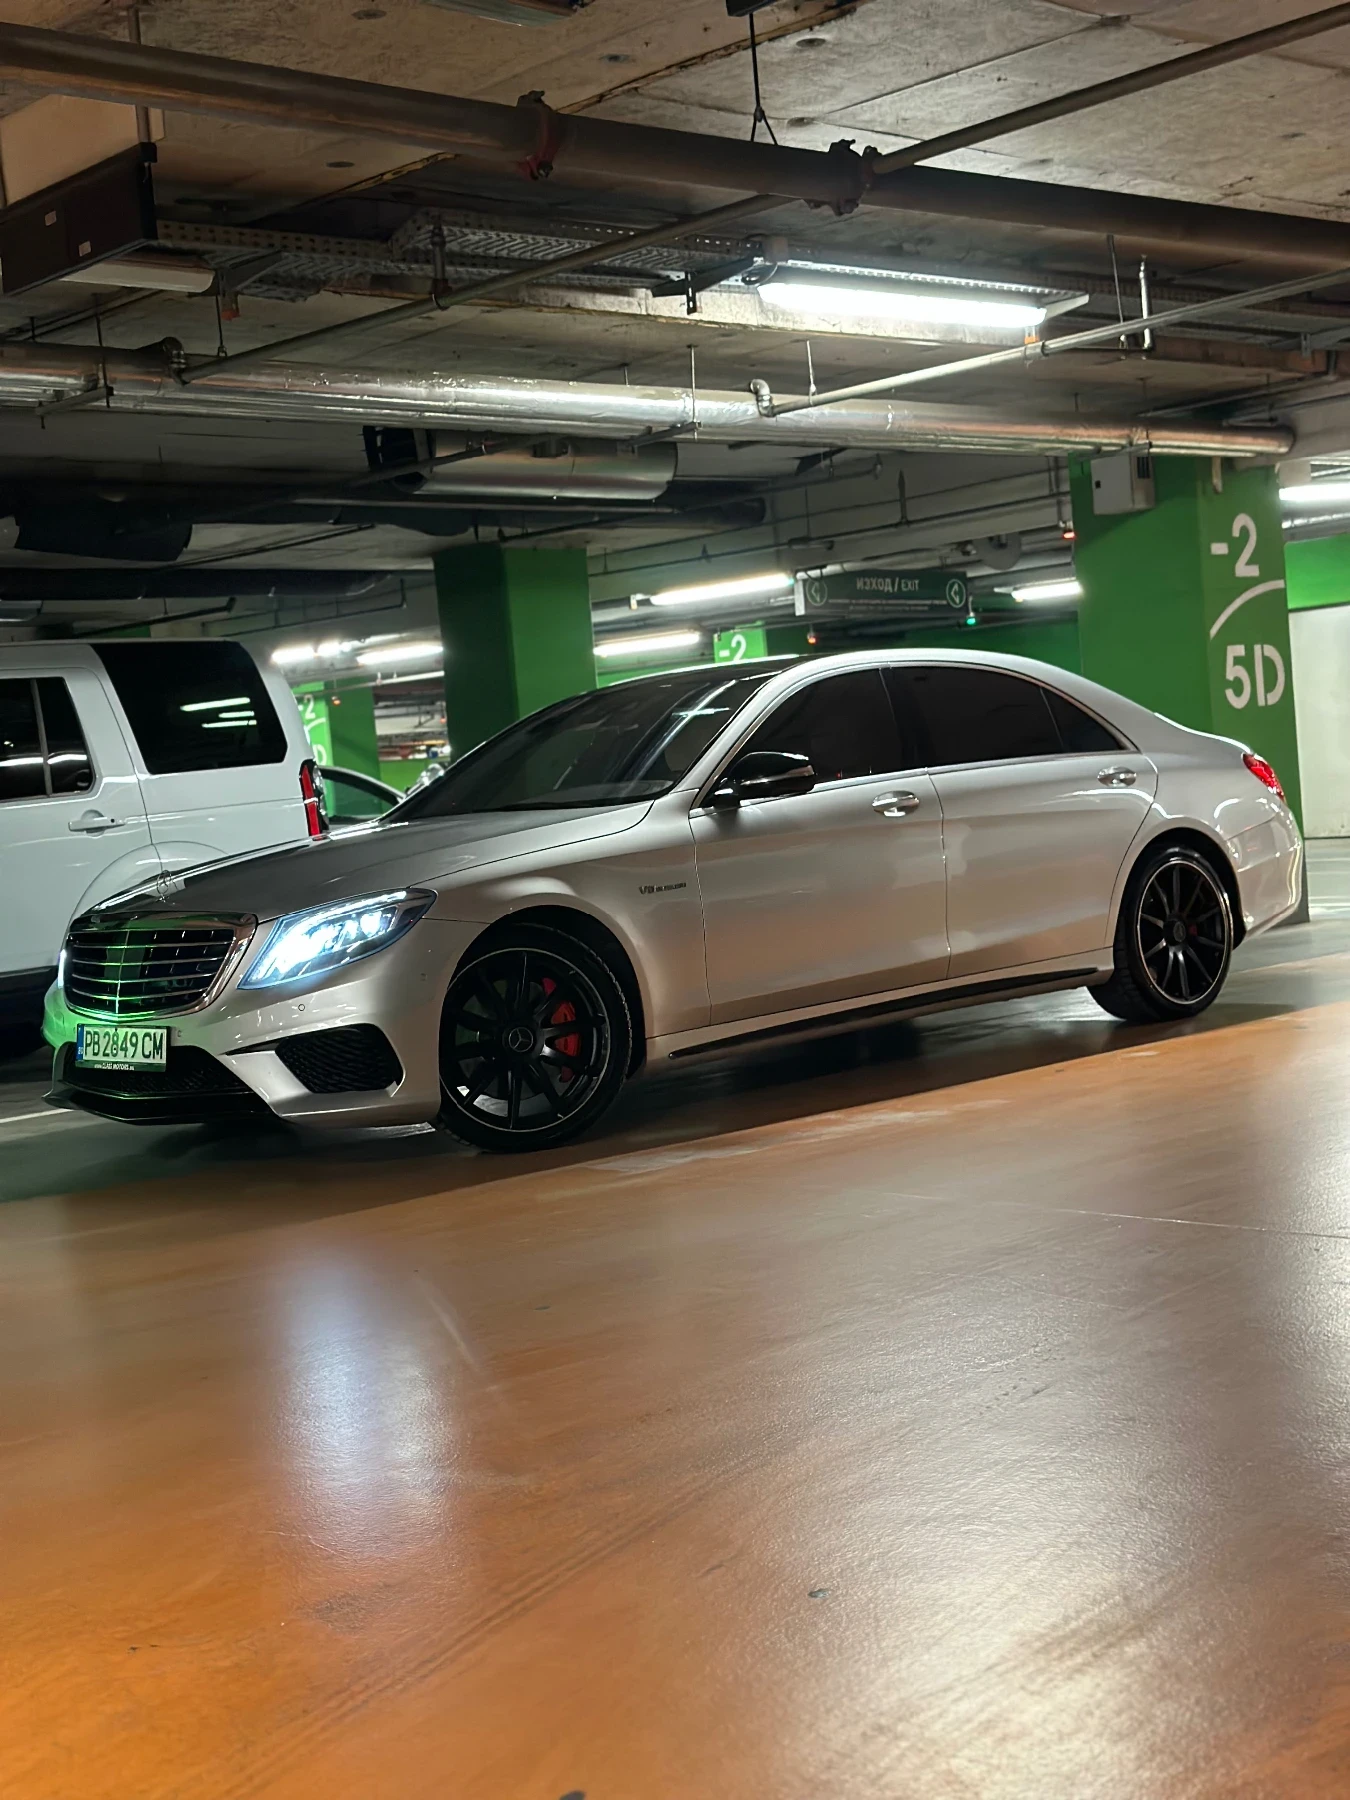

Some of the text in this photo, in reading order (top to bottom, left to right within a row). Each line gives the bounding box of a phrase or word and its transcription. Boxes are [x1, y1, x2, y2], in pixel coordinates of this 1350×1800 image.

[1211, 513, 1259, 577] -2
[856, 577, 893, 593] ИЗХОД
[901, 579, 919, 592] EXIT
[719, 634, 747, 661] -2
[1225, 644, 1285, 709] 5D
[85, 1030, 163, 1060] PB 2849 CM
